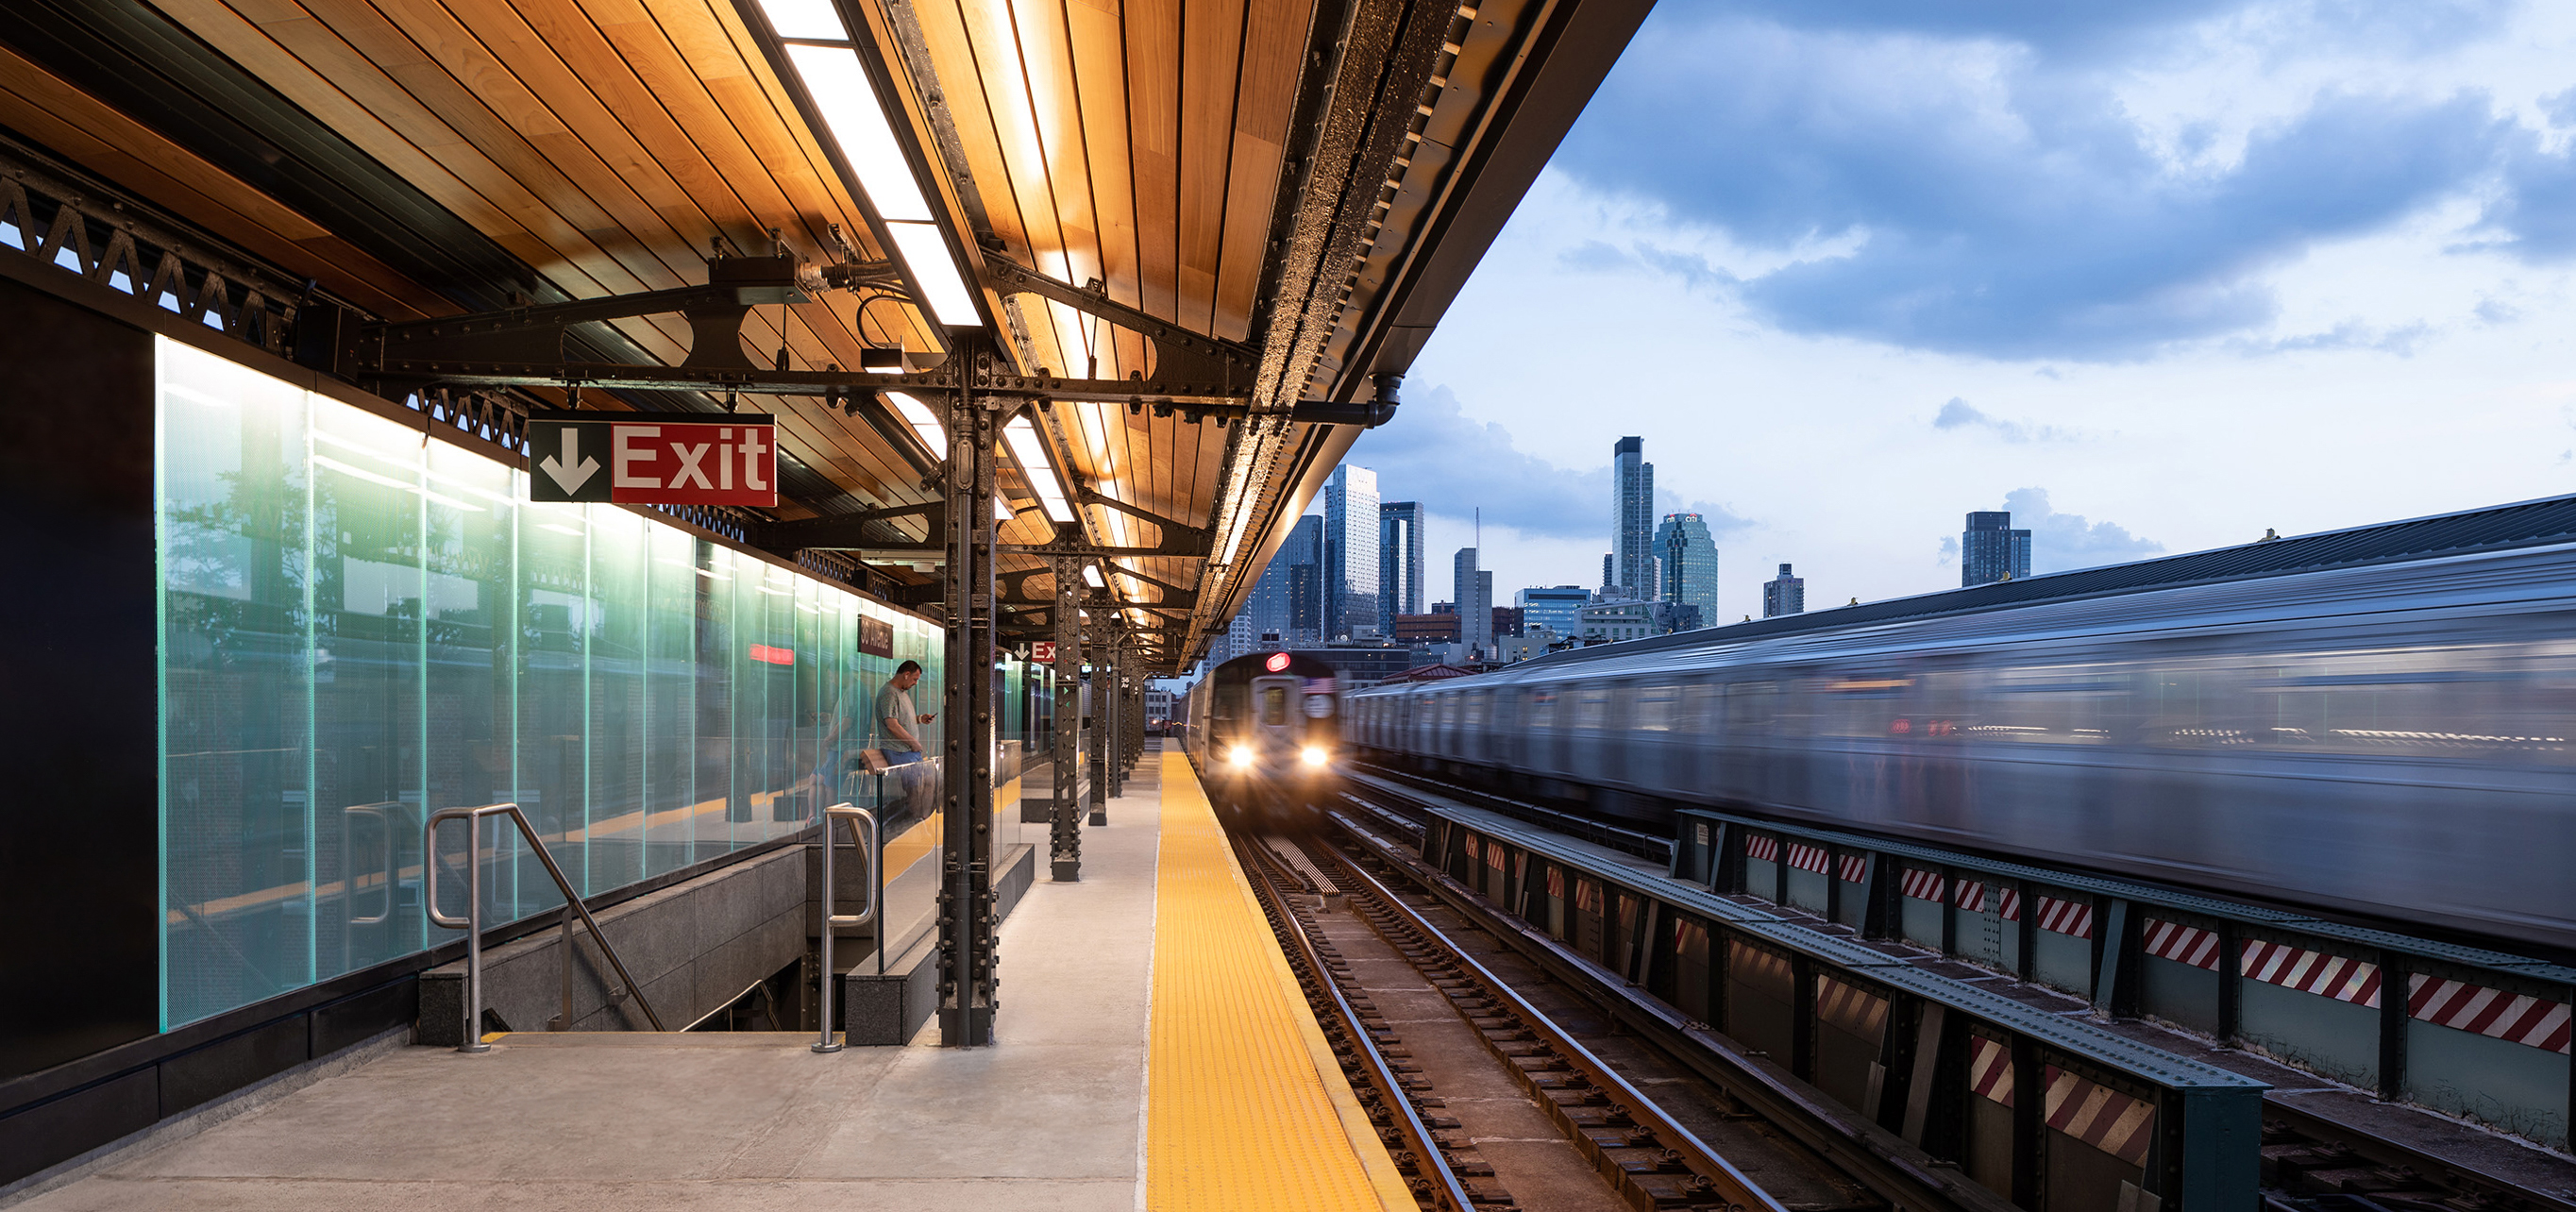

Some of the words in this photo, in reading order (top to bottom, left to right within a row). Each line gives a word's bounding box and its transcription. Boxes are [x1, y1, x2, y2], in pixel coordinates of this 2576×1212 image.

[614, 426, 766, 491] Exit
[861, 619, 869, 645] 36
[870, 623, 889, 650] Avenue
[1032, 642, 1056, 659] Ex
